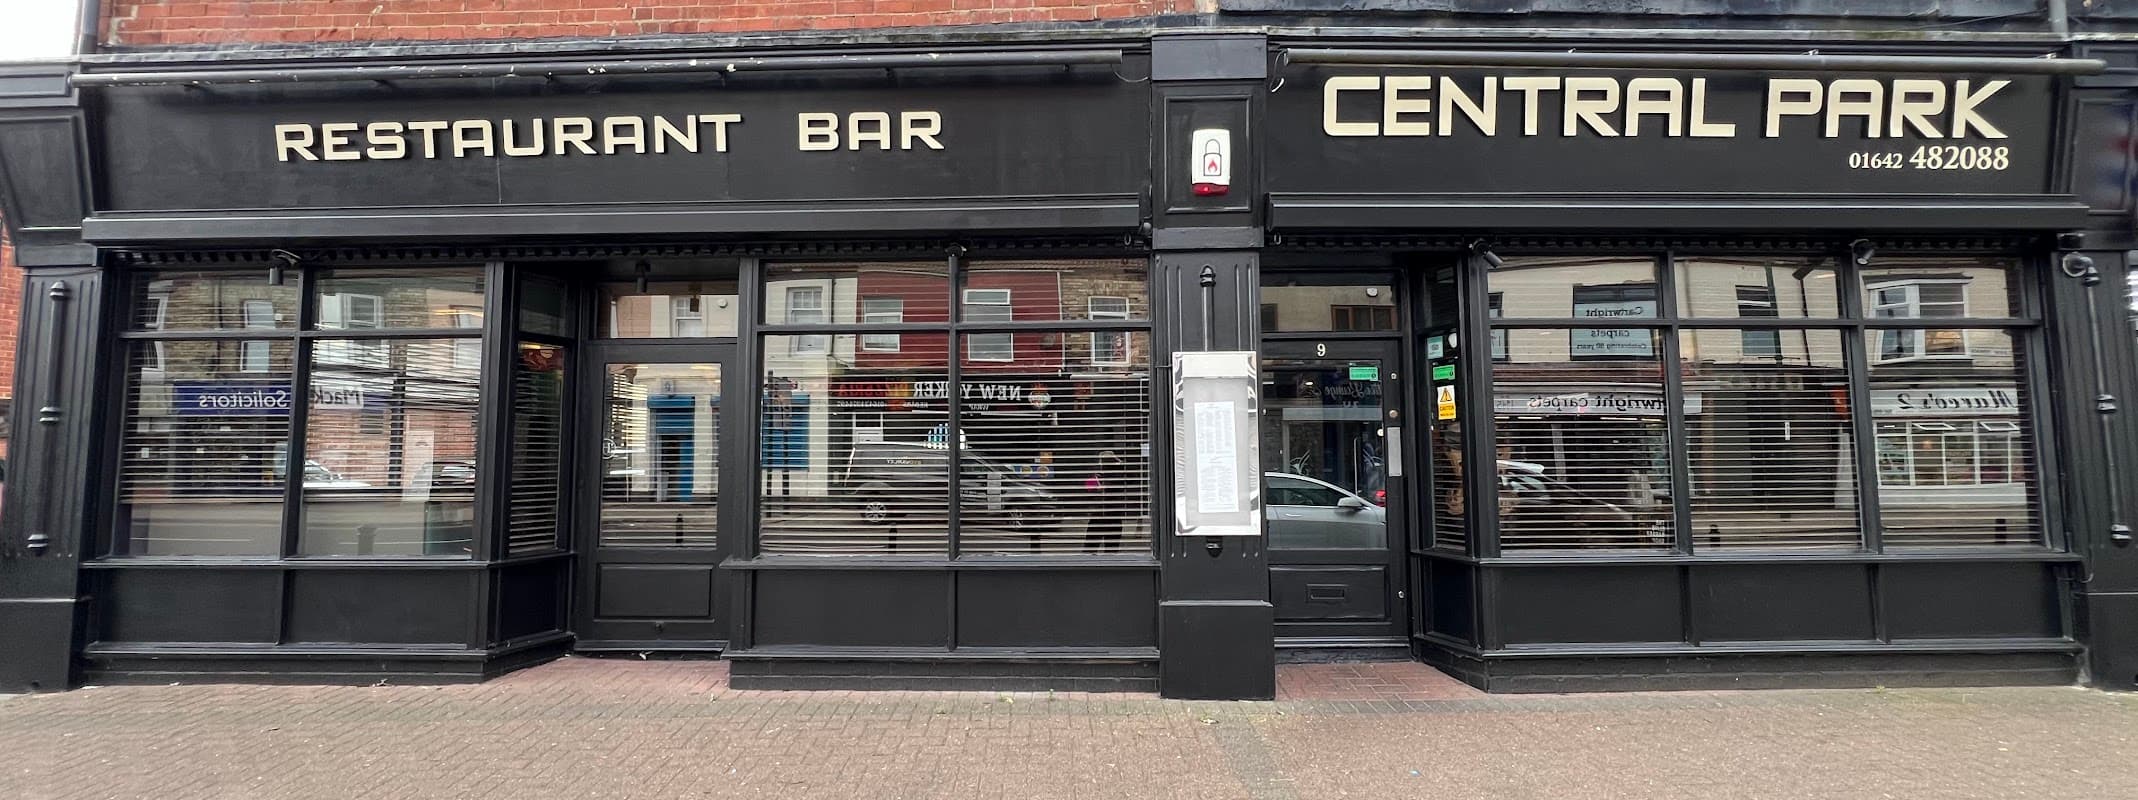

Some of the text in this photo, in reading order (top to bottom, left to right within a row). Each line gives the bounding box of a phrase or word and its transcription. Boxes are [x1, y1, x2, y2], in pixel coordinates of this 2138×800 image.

[1323, 76, 2012, 139] CENTRAL PARK
[274, 110, 946, 162] RESTAURANT BAR
[1848, 144, 2010, 171] 01642 482088
[1316, 343, 1326, 357] 9
